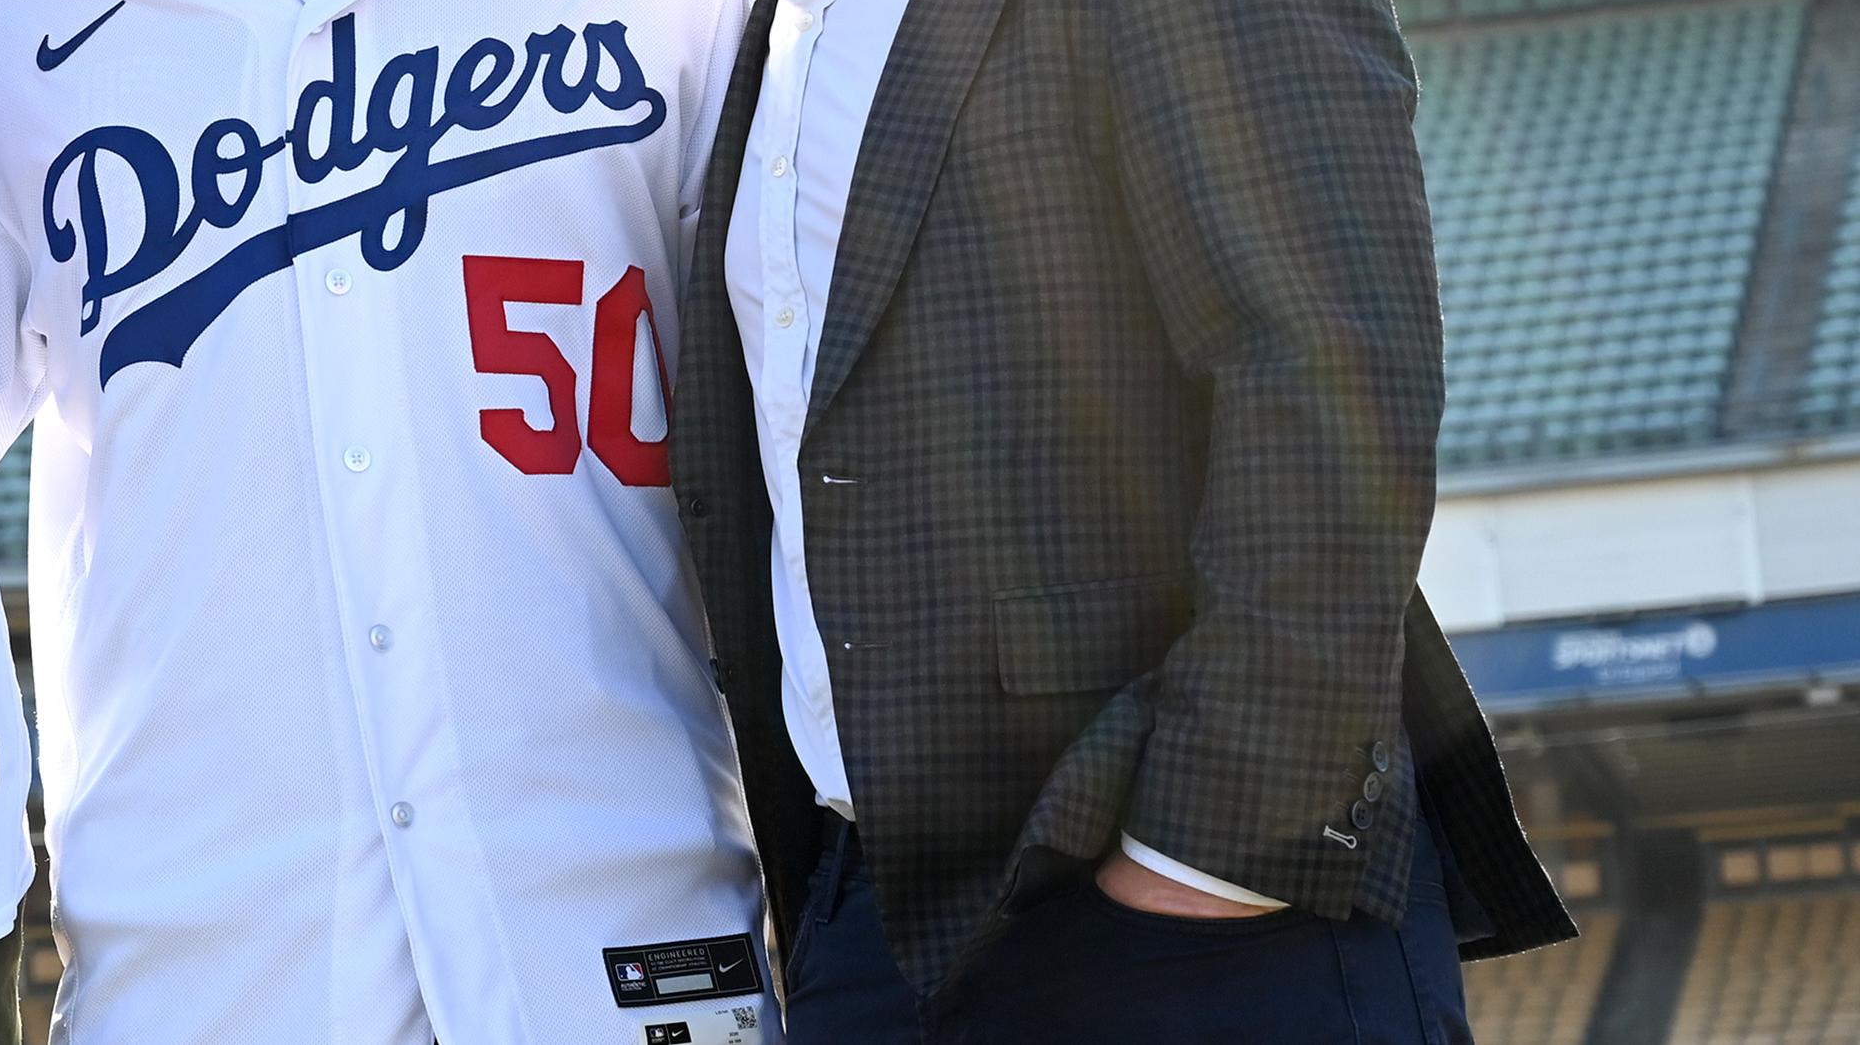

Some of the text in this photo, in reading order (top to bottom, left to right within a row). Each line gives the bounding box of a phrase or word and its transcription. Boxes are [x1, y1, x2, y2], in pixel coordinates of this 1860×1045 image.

[42, 12, 667, 364] Dodgers
[462, 255, 673, 487] 50
[647, 947, 706, 962] ENGINEERED
